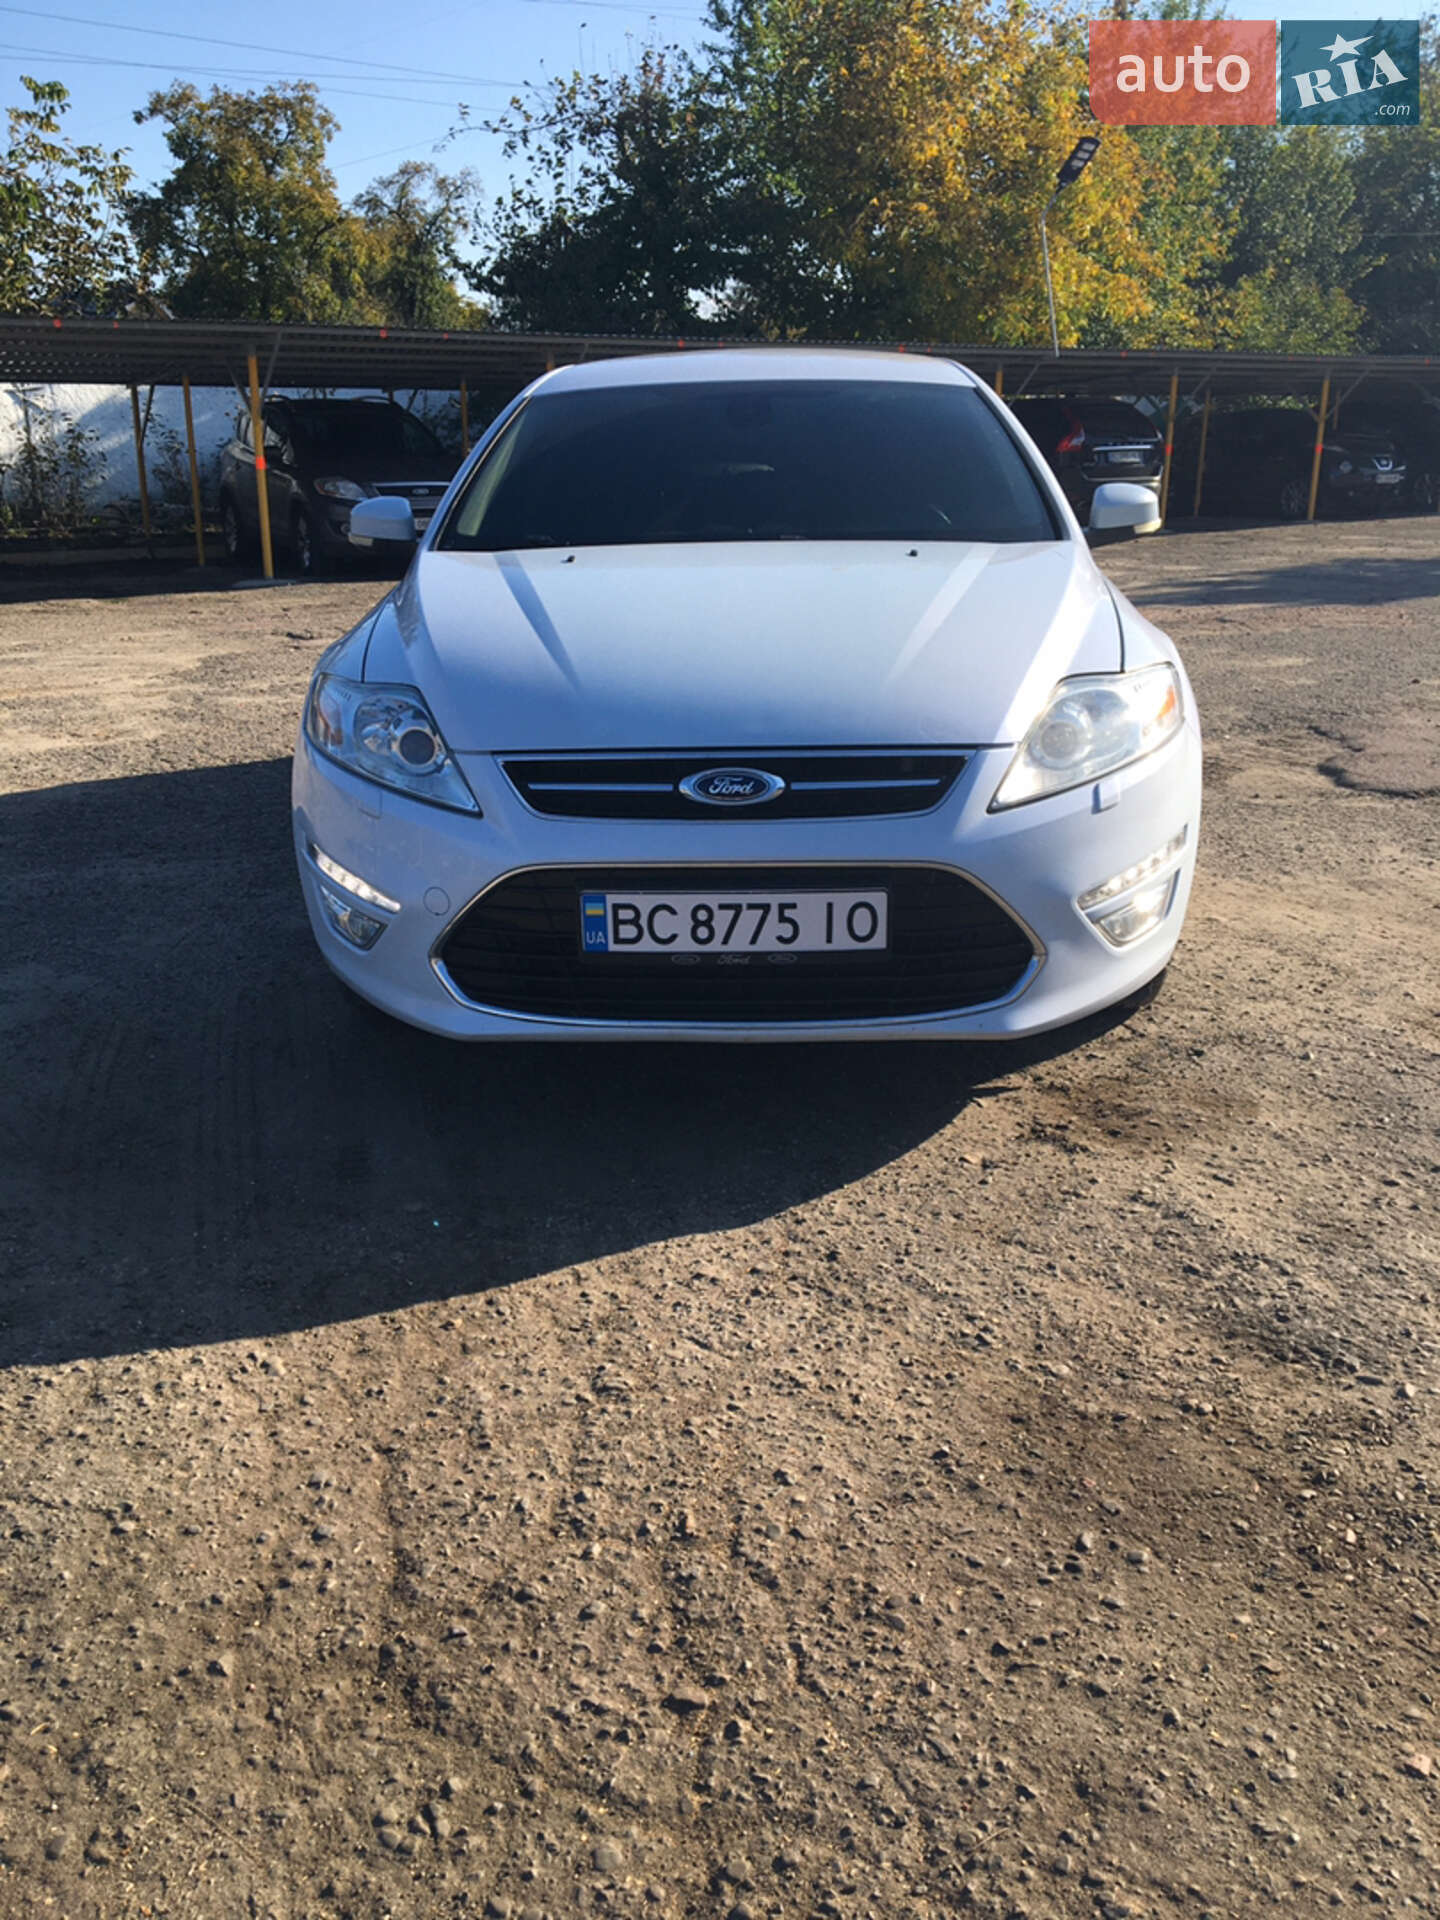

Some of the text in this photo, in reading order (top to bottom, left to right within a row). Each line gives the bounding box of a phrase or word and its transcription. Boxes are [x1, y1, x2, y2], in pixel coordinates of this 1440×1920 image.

[708, 775, 755, 795] Ford
[611, 902, 679, 945] BC
[690, 901, 801, 945] 8775
[586, 931, 606, 944] UA
